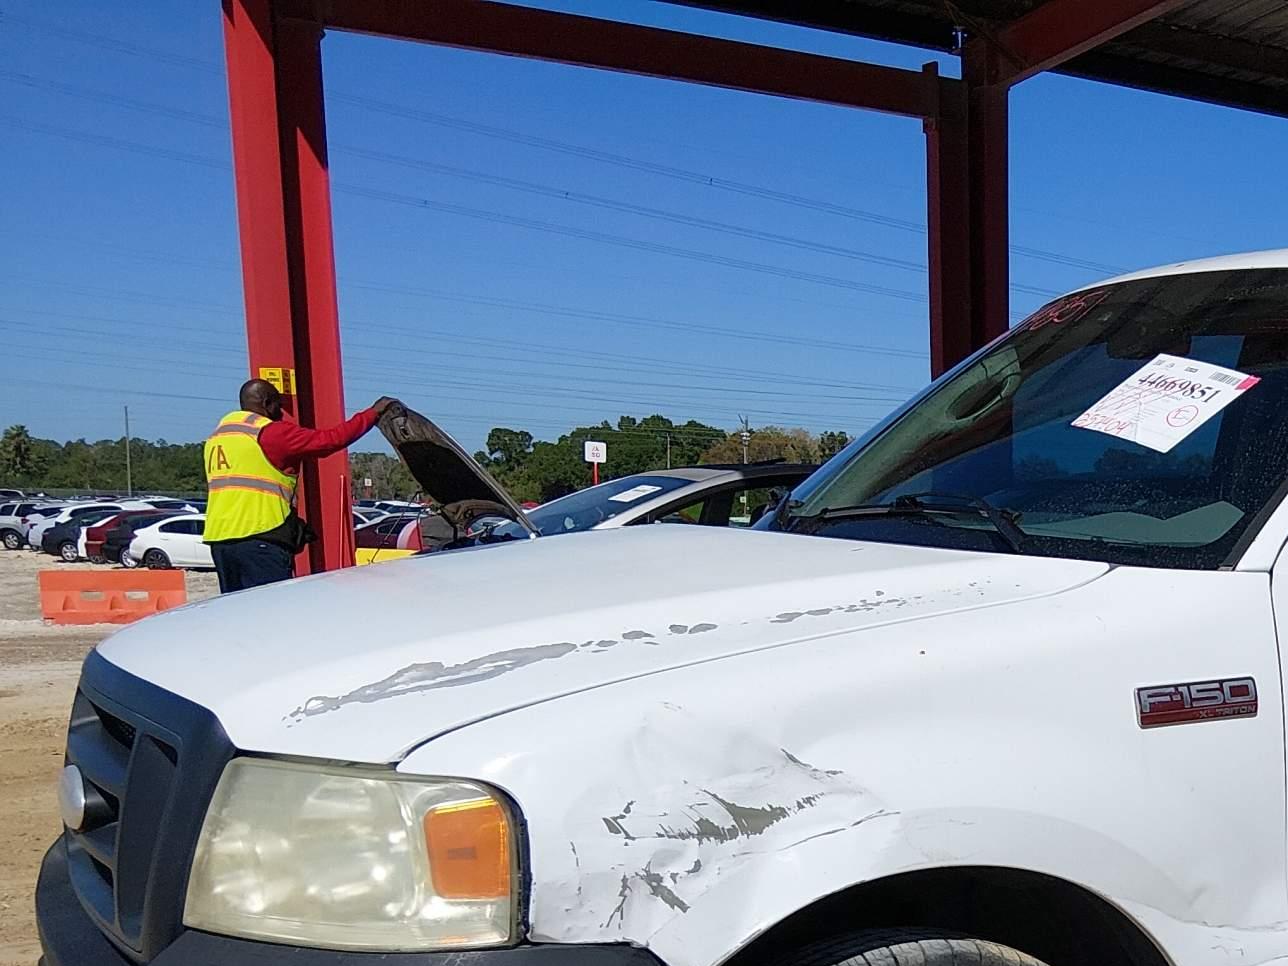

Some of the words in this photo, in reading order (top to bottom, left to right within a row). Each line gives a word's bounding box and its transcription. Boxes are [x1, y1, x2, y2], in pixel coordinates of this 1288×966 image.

[1138, 372, 1222, 403] 44669851
[1139, 679, 1256, 713] F-150
[1199, 709, 1214, 718] XL
[1215, 705, 1256, 716] TRITON
